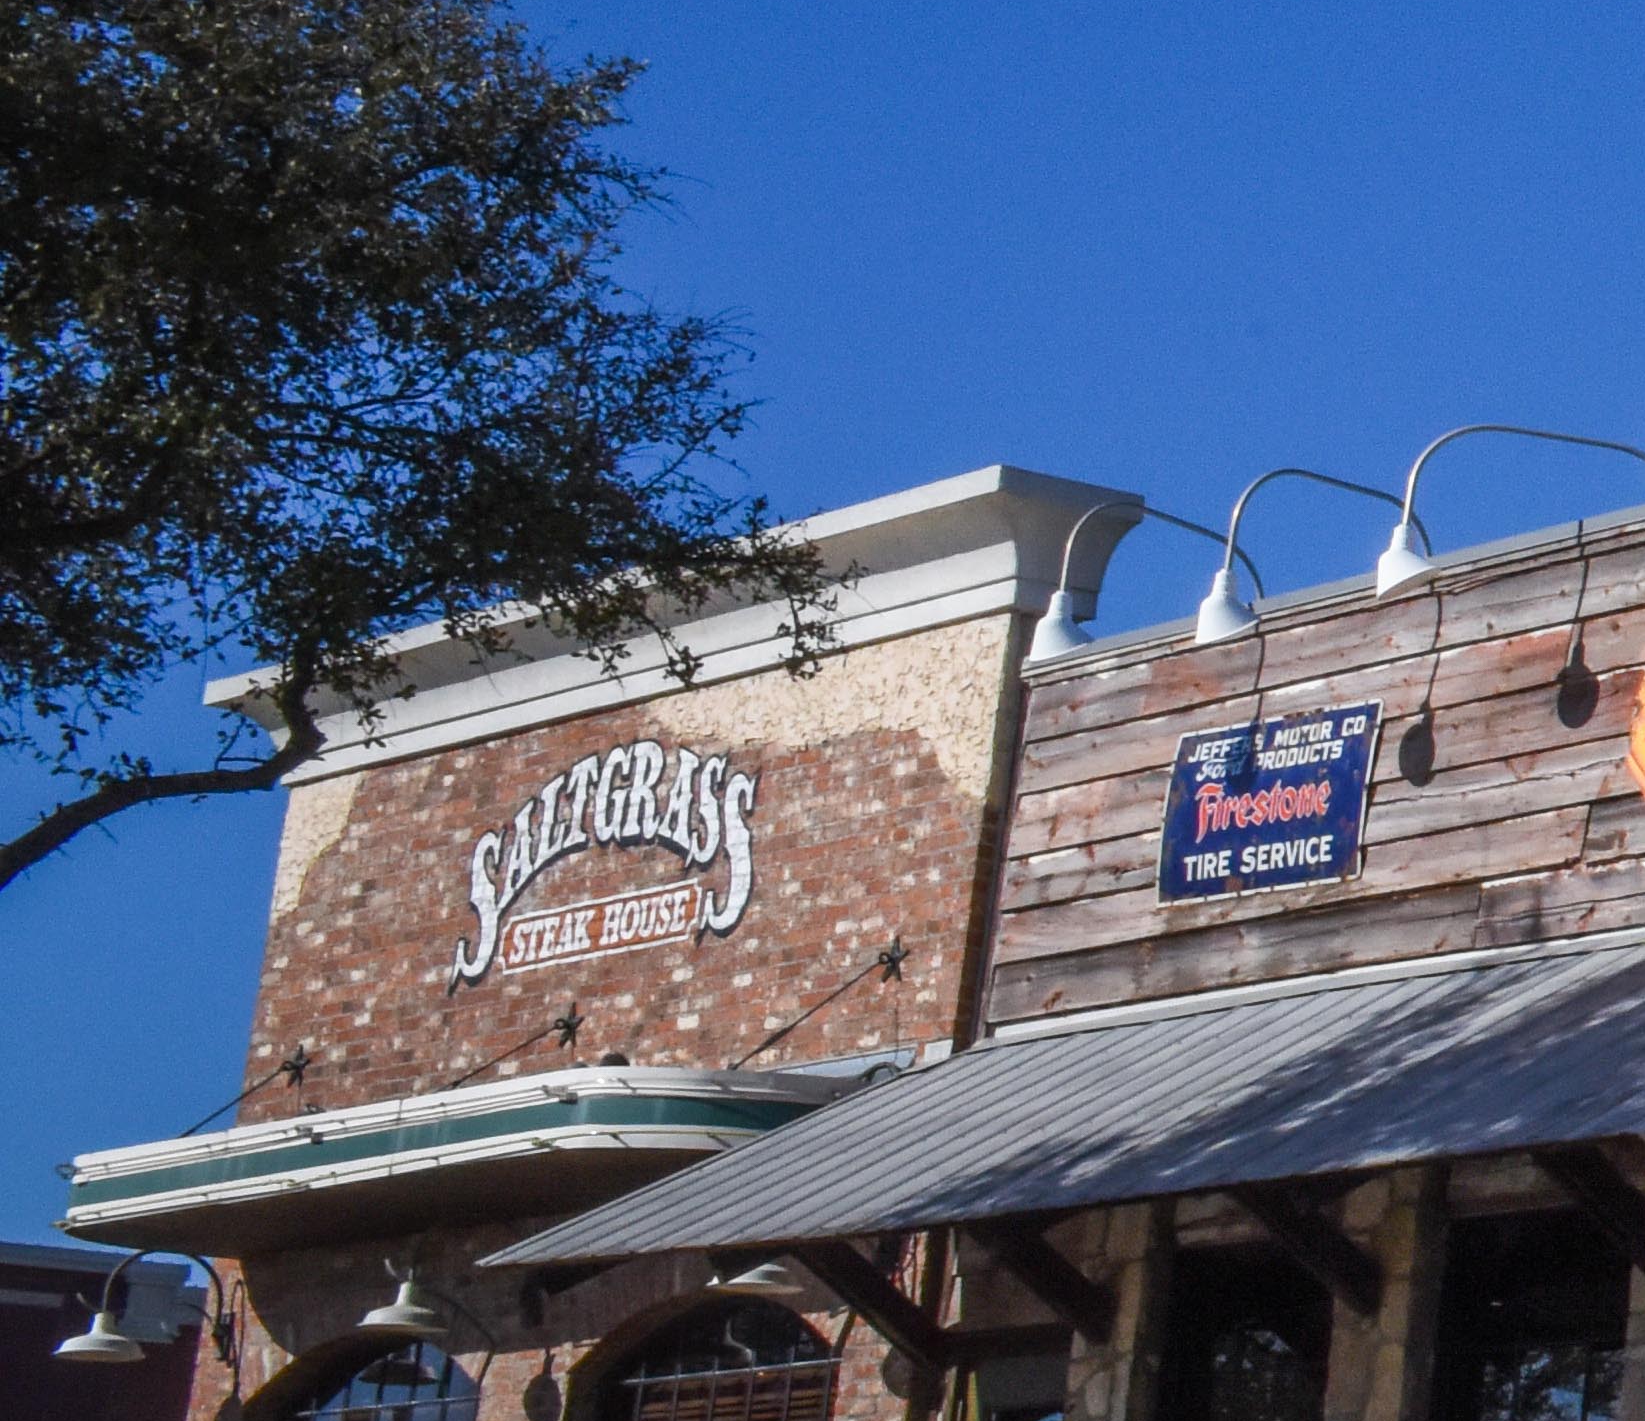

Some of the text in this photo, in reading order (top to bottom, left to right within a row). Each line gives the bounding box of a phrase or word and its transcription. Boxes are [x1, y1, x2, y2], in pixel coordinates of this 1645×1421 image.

[1255, 739, 1344, 770] PRODUCTS
[1274, 720, 1333, 748] MOTOR
[1341, 715, 1367, 737] CO
[1195, 779, 1333, 844] Firestone
[449, 739, 760, 992] SALTGRASS
[1184, 834, 1334, 882] TIRE SERVICE
[508, 889, 692, 965] STEAK HOUSE
